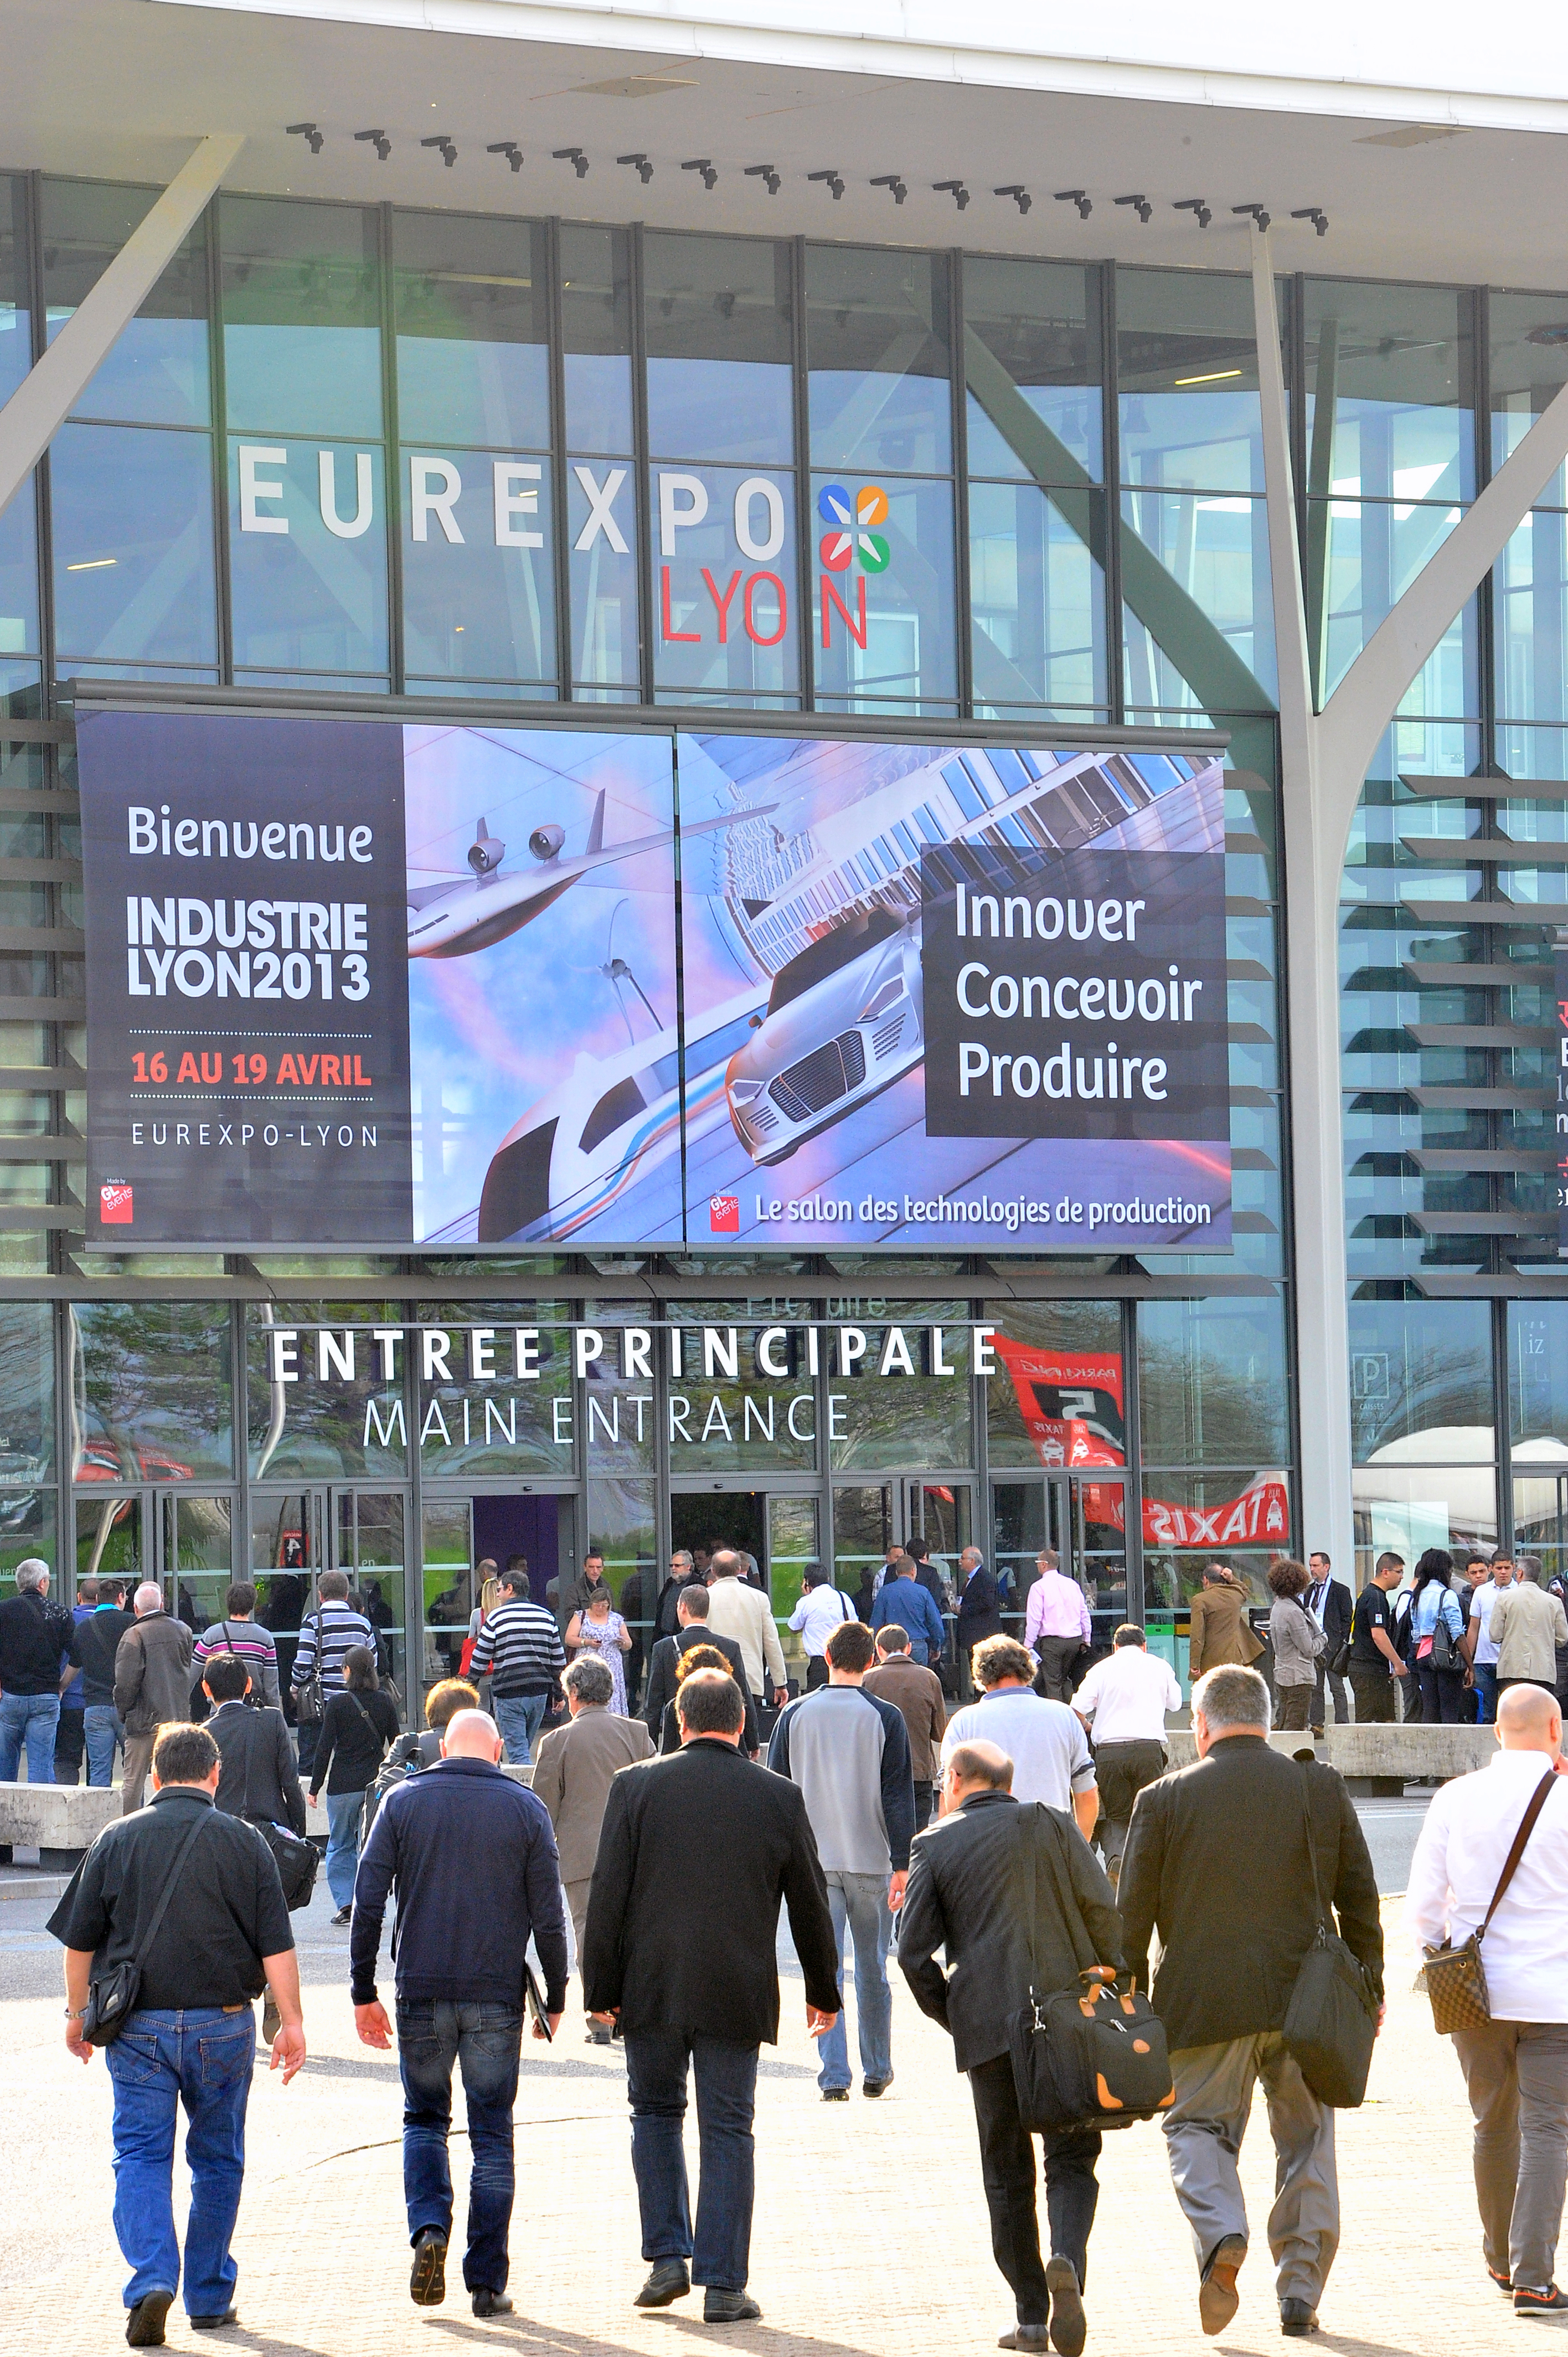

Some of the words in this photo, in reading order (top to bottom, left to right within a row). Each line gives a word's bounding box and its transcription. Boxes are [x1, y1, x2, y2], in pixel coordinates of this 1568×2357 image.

[239, 446, 785, 561] EUREXPO
[663, 566, 868, 650] LYON
[128, 805, 373, 863] Bienvenue
[127, 896, 368, 951] INDUSTRIE
[956, 882, 1146, 941] Innover
[127, 949, 370, 1001] LYON2013
[956, 962, 1203, 1022] Concevoir
[131, 1051, 167, 1083] 16
[177, 1052, 222, 1084] AU
[232, 1053, 267, 1085] 19
[276, 1053, 372, 1086] AVRIL
[959, 1042, 1168, 1100] Produire
[132, 1123, 378, 1147] EUREXPO-LYON
[101, 1186, 120, 1201] GL
[107, 1188, 133, 1210] events
[710, 1196, 727, 1211] GL
[715, 1198, 739, 1219] events
[756, 1194, 782, 1221] Le
[787, 1193, 852, 1221] salon
[859, 1194, 898, 1222] des
[904, 1195, 1050, 1231] technologies
[1055, 1196, 1083, 1223] de
[1089, 1196, 1211, 1230] production
[271, 1329, 540, 1382] ENTREE
[576, 1326, 996, 1379] PRINCIPALE
[363, 1397, 517, 1447] MAIN
[553, 1394, 849, 1444] ENTRANCE
